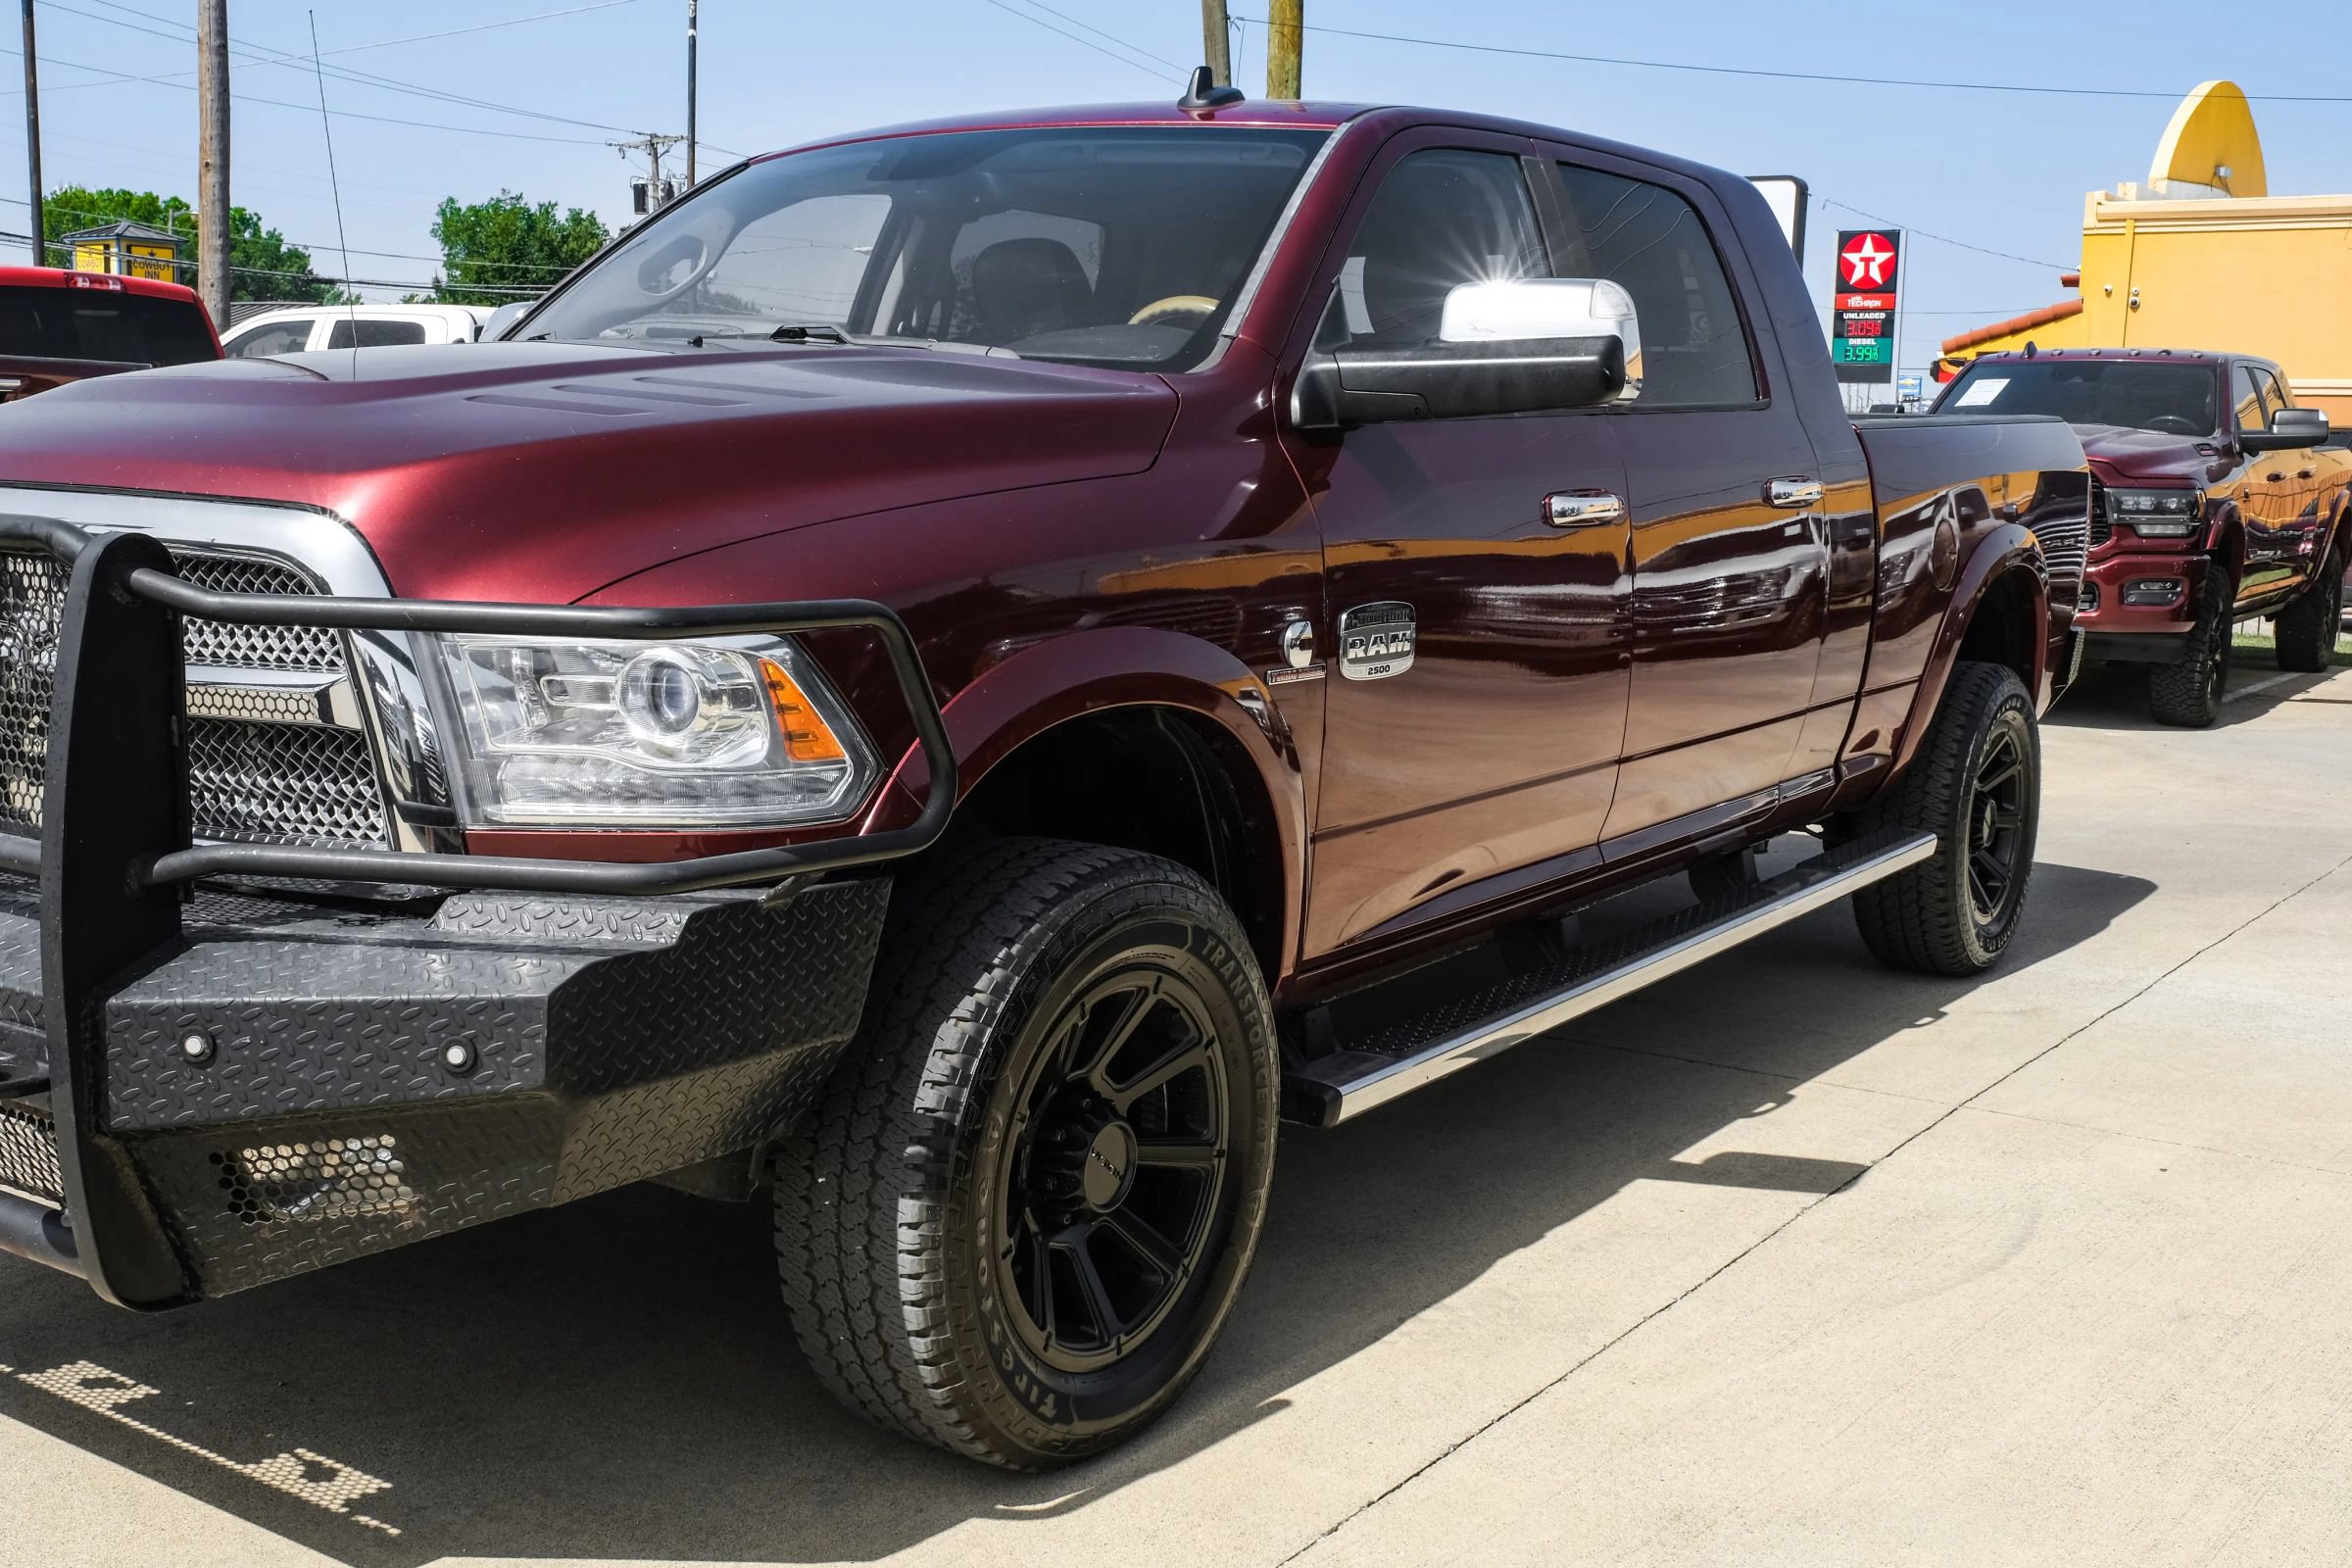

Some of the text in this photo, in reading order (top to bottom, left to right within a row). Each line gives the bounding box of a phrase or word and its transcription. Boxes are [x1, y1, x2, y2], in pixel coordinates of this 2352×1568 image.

[77, 259, 103, 269] COWBOY
[132, 259, 172, 270] COWBOY
[144, 270, 160, 279] INN
[1846, 299, 1882, 308] TECHRON
[1847, 321, 1874, 336] 3.09
[1845, 346, 1872, 362] 3.99
[1348, 630, 1411, 660] RAM
[1368, 664, 1391, 675] 2500
[1200, 934, 1271, 1103] TRANSFORCE
[976, 1175, 1058, 1419] Firestone
